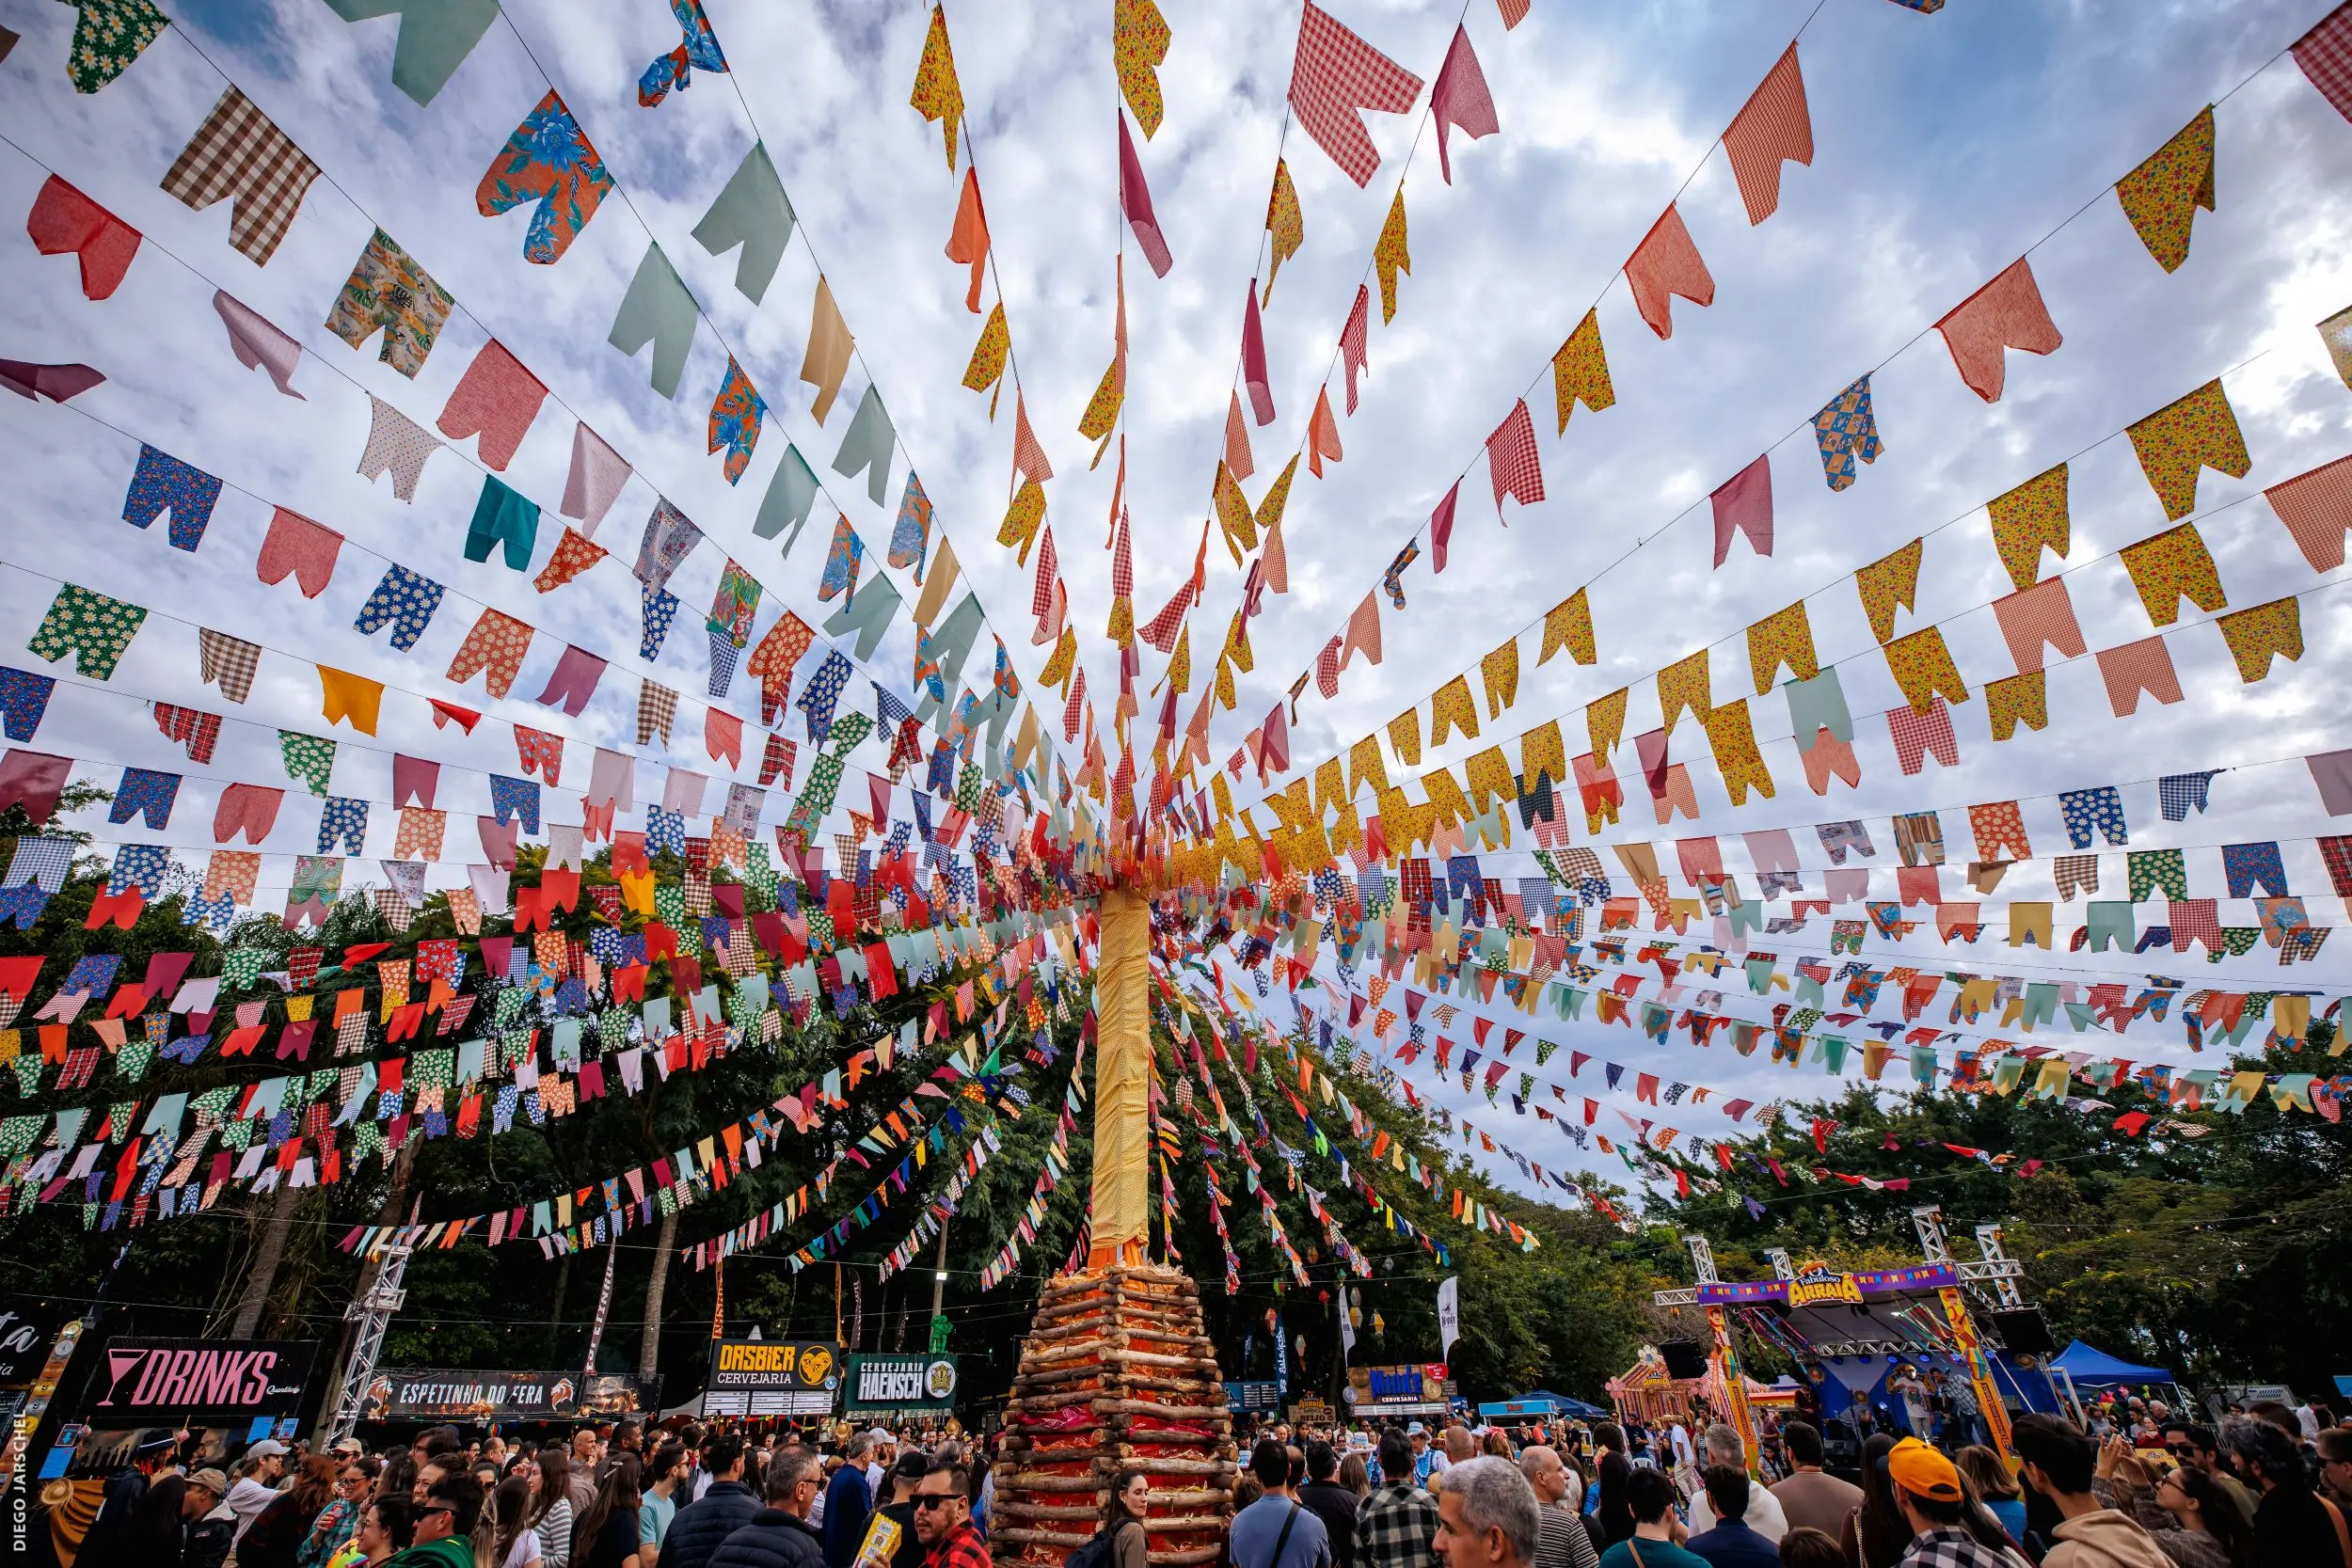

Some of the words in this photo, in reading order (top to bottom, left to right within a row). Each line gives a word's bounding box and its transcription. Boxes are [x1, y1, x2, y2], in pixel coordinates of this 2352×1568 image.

[1789, 1273, 1862, 1307] ARRAIÁ
[1799, 1274, 1841, 1286] Fabuloso
[130, 1349, 278, 1405] DRINKS
[860, 1362, 924, 1372] CERVEJARIA
[717, 1373, 792, 1385] CERVEJARIA
[857, 1372, 924, 1401] HAENSCH
[399, 1383, 483, 1405] ESPETINHO
[486, 1384, 508, 1405] DO
